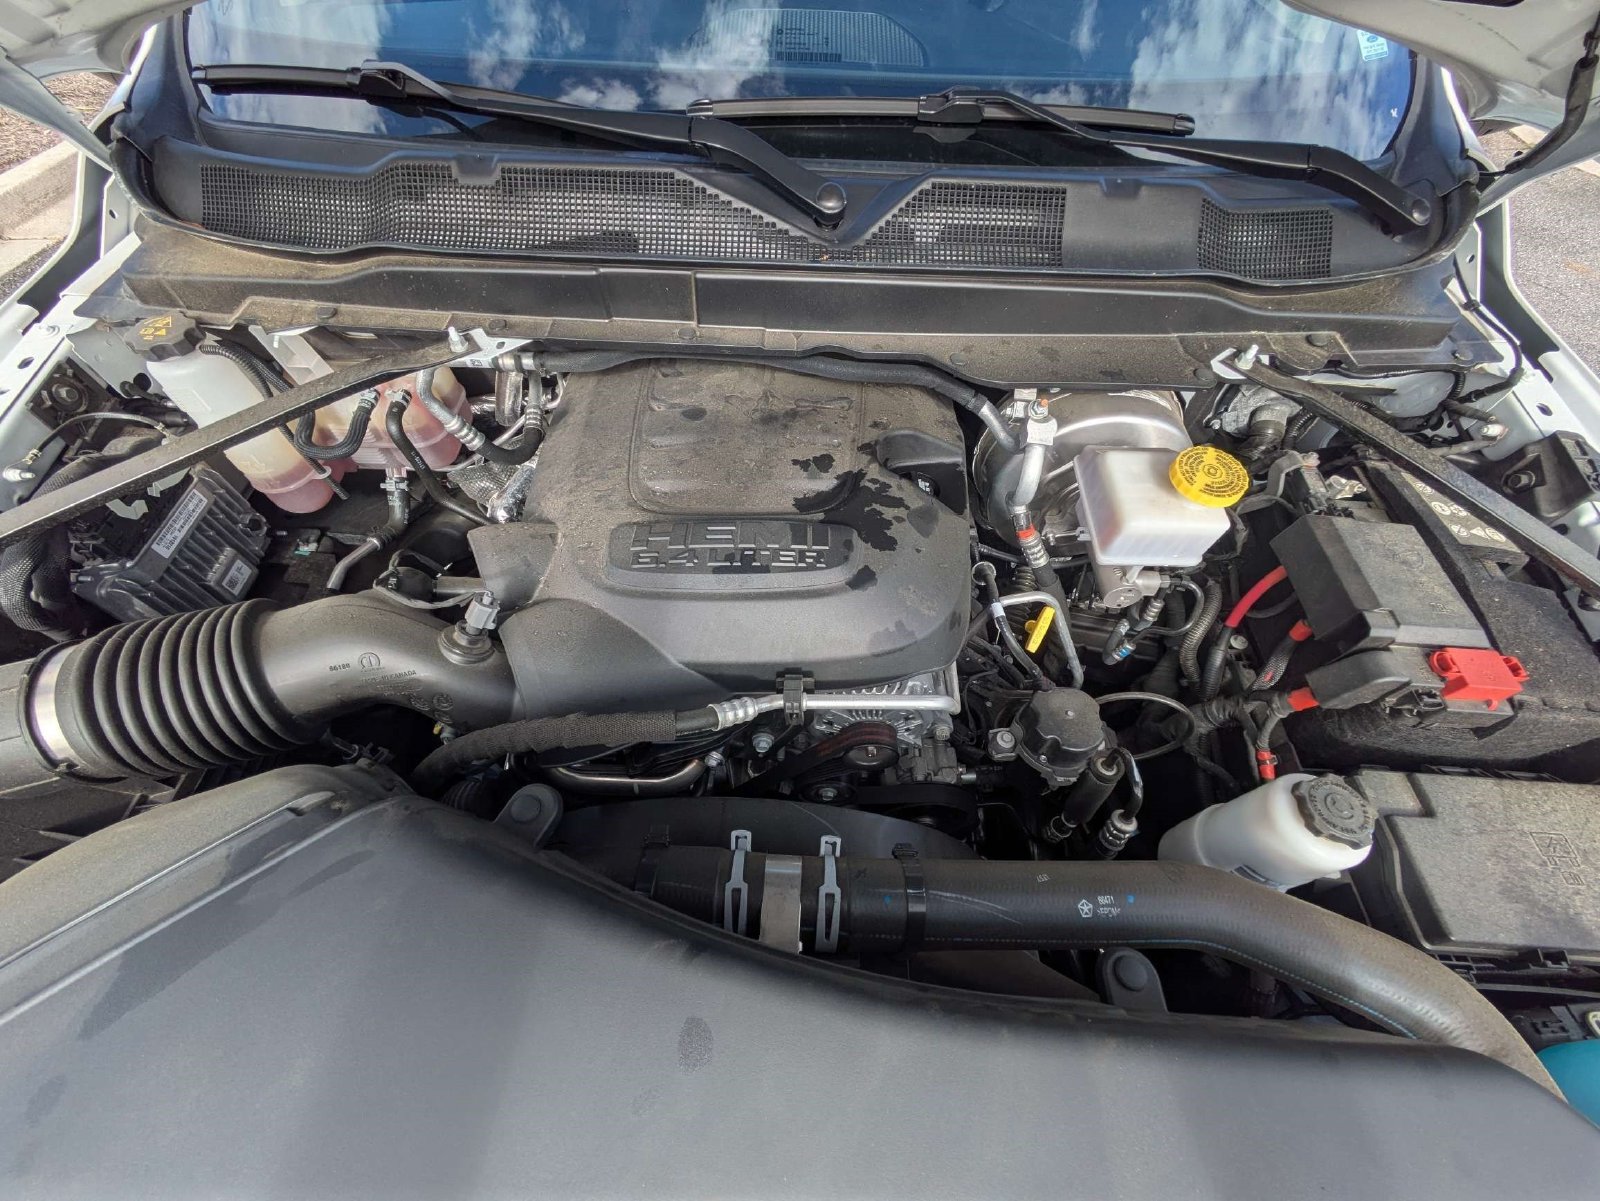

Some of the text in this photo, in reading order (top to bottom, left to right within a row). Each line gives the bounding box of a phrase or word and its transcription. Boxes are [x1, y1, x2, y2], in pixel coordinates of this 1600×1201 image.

[630, 521, 831, 550] HEMI
[631, 549, 828, 568] 6.4 LITER
